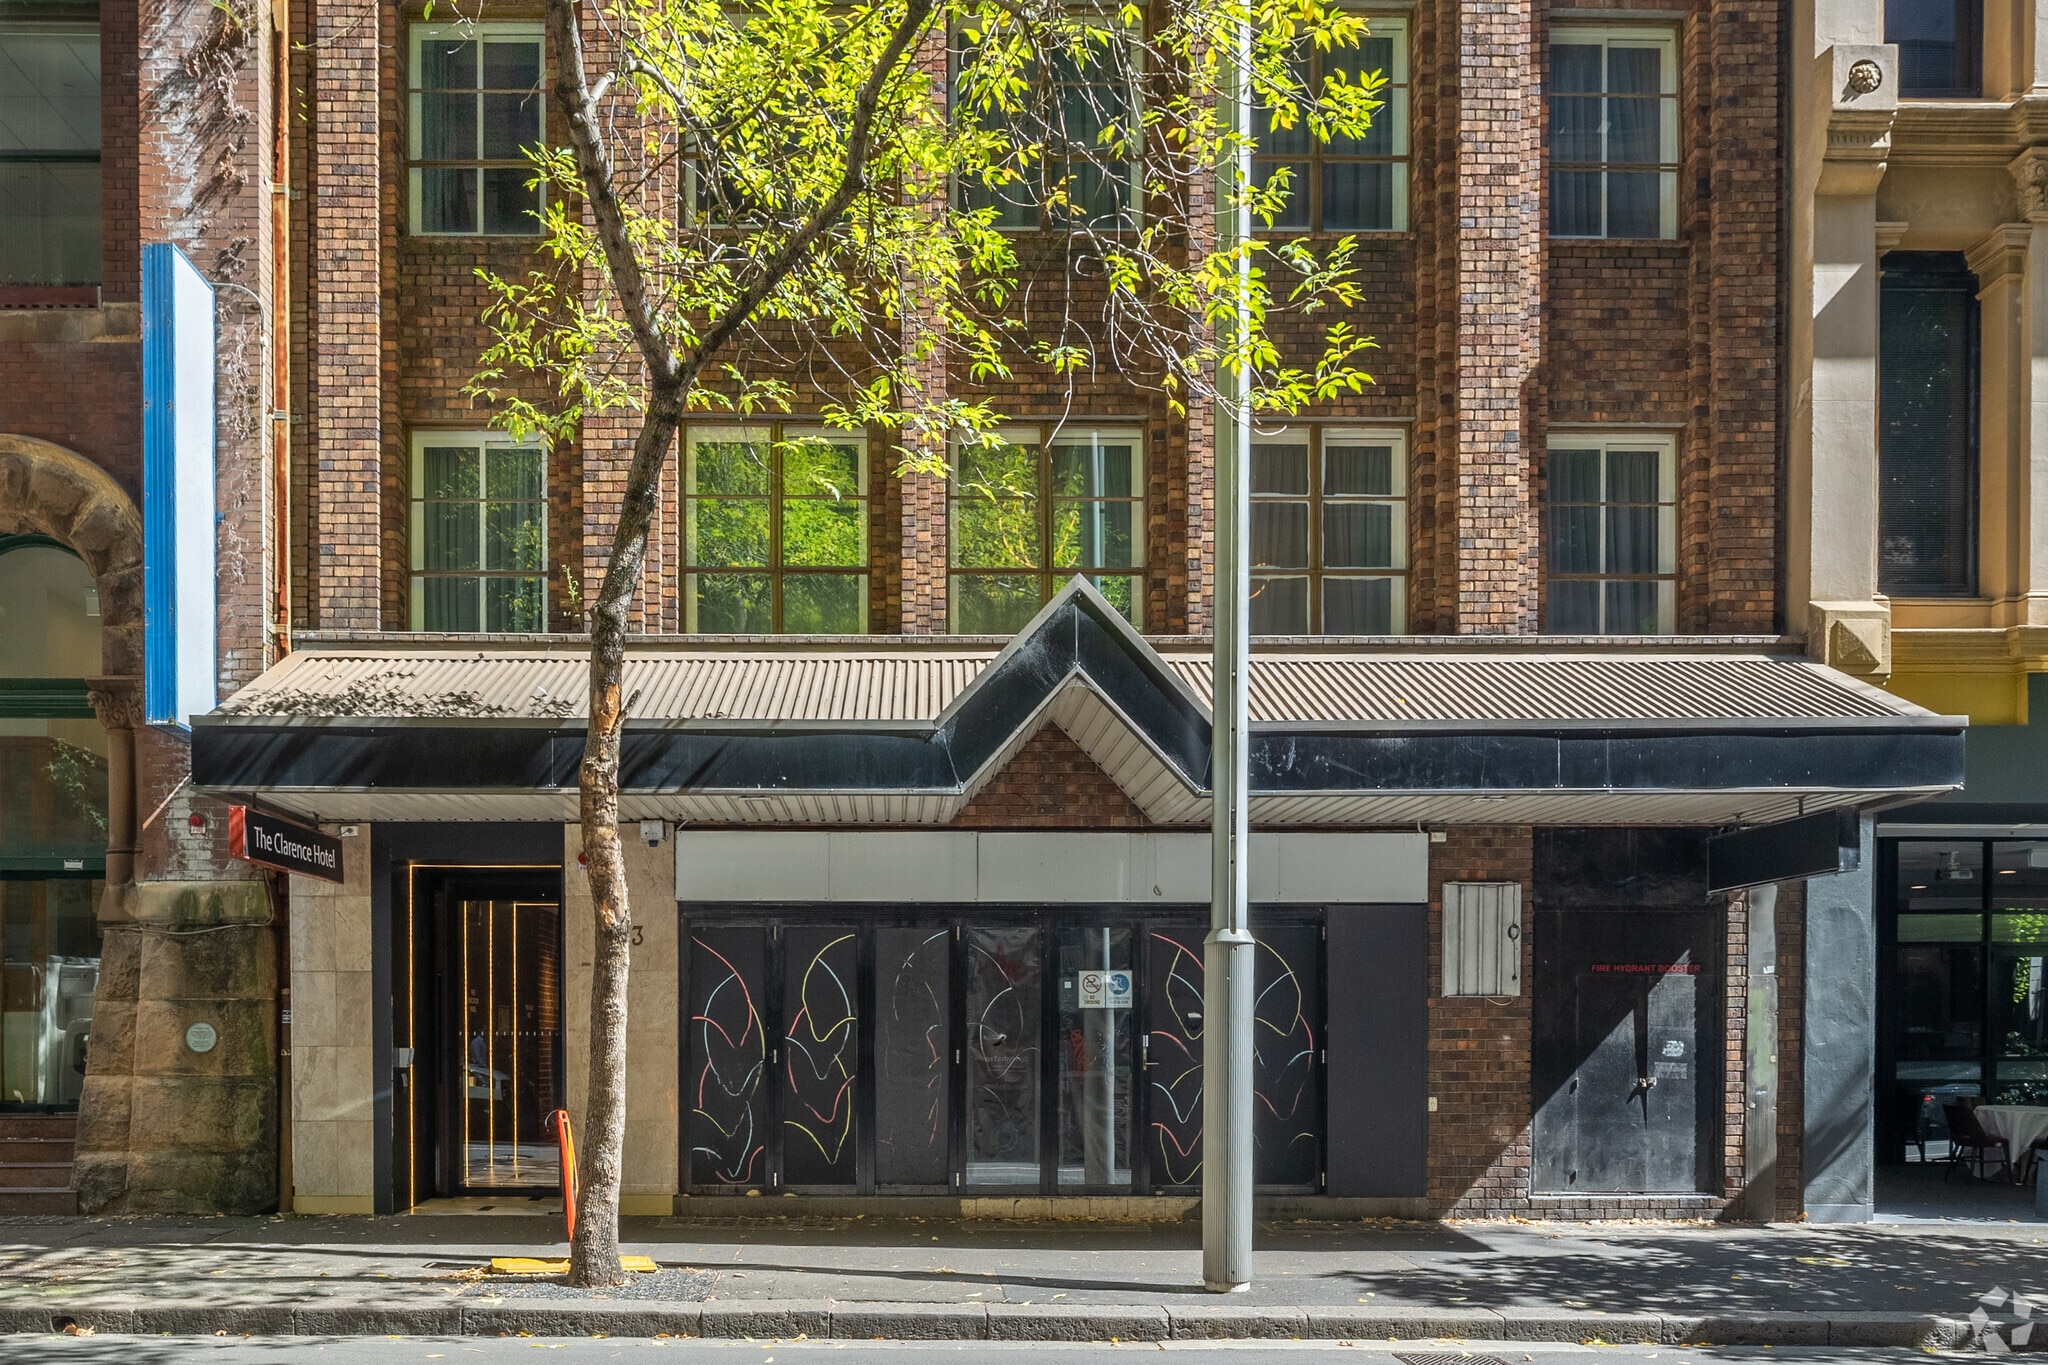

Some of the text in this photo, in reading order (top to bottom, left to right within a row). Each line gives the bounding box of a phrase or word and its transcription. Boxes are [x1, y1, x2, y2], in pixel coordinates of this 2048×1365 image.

[253, 826, 336, 869] The Clarence Hotel
[1591, 964, 1701, 973] FIRE HYDRANT BOOSTER
